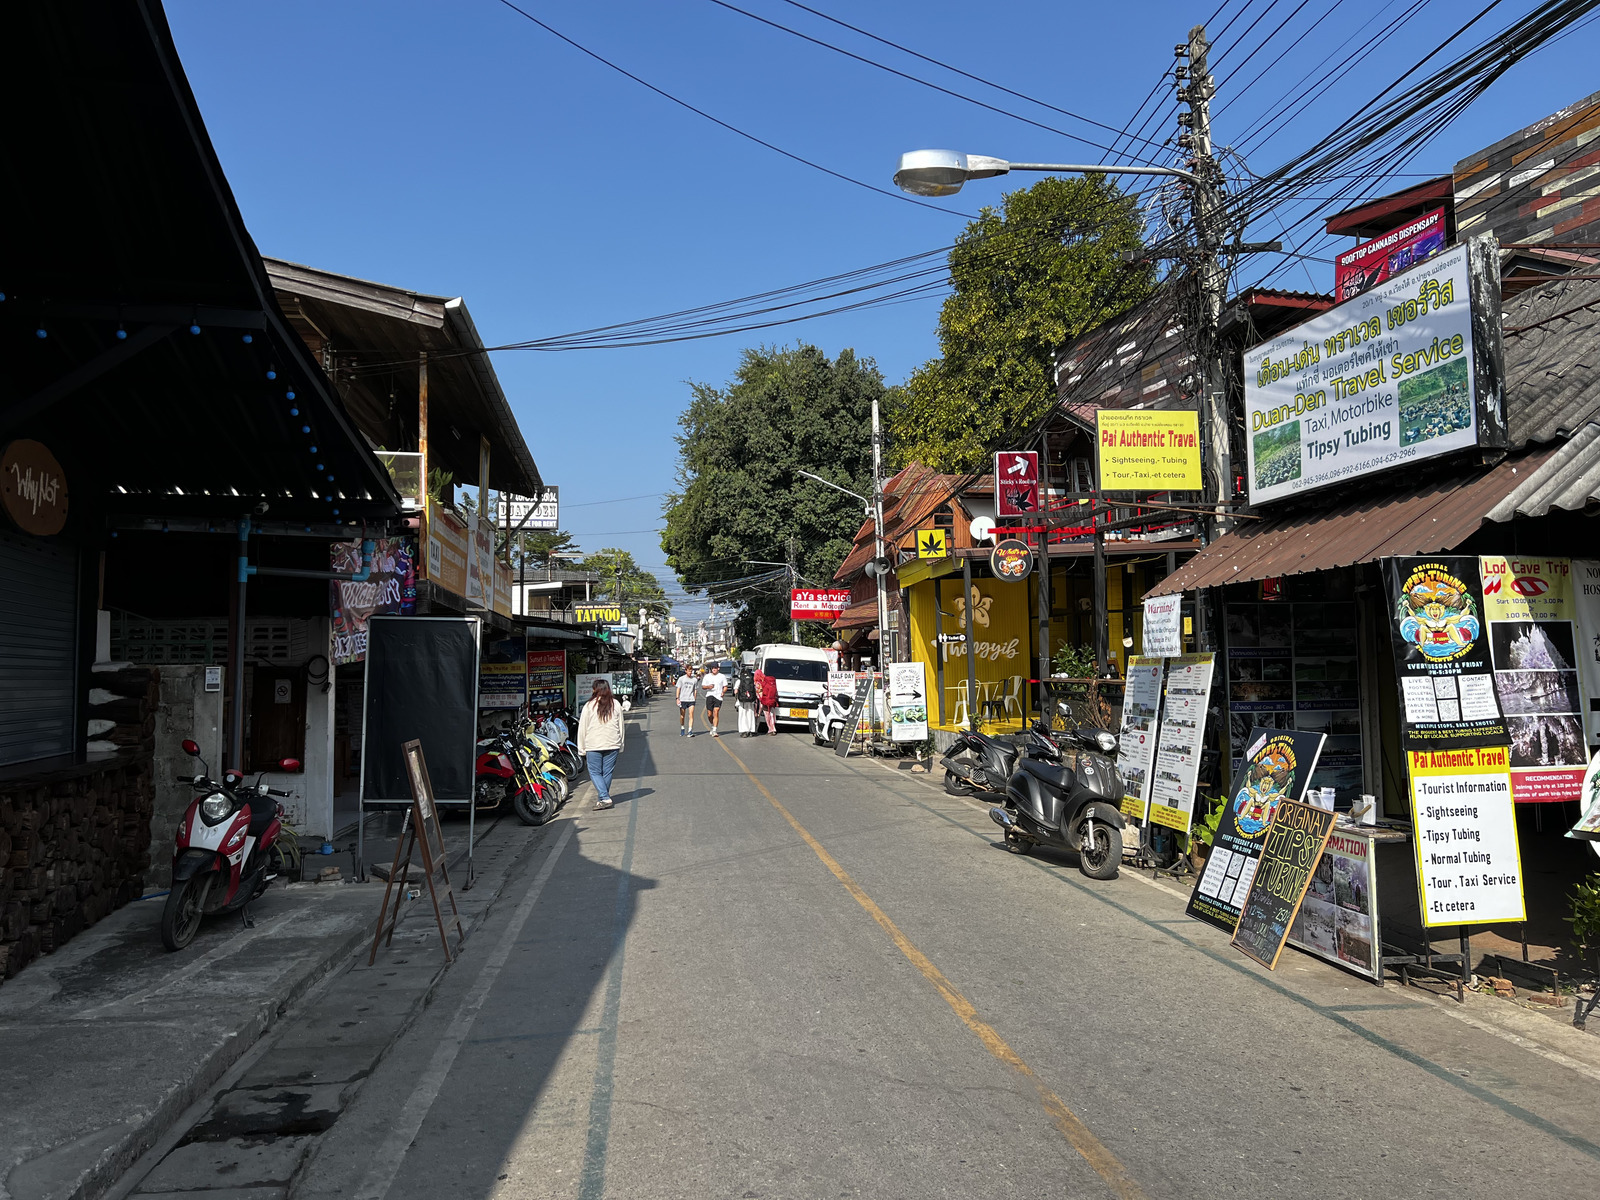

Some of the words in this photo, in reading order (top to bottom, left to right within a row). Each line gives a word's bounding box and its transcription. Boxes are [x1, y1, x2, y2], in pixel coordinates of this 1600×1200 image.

[1341, 247, 1367, 266] ROOFTOP
[1367, 234, 1398, 255] CANNABIS
[1398, 213, 1439, 241] DISPENSARY
[1324, 316, 1381, 358] ทราเวล
[1252, 389, 1326, 433] Duan-Den
[1330, 360, 1386, 402] Travel
[1391, 333, 1464, 379] Service
[1102, 430, 1117, 448] Pai
[1120, 430, 1166, 448] Authentic
[1168, 430, 1197, 448] Travel
[1307, 438, 1340, 460] Tipsy
[1344, 420, 1391, 448] Tubing
[1162, 456, 1188, 465] Tubing
[1412, 563, 1448, 572] ORIGINAL
[1484, 561, 1506, 574] Lod
[1512, 561, 1540, 574] Cave
[1546, 561, 1569, 576] Trip
[1428, 570, 1468, 594] TUBING
[796, 592, 814, 601] aYa
[575, 608, 620, 622] TATTOO
[1148, 600, 1176, 615] Warning!
[1414, 750, 1428, 769] Pai
[1430, 749, 1474, 768] Authentic
[1476, 748, 1506, 766] Travel
[1456, 780, 1507, 794] Information
[1276, 802, 1326, 838] ORIGINAL
[1426, 805, 1478, 820] Sightseeing
[1452, 828, 1480, 842] Tubing
[1268, 823, 1323, 870] TIPSY
[1326, 836, 1368, 858] RMATION
[1430, 852, 1462, 865] Normal
[1463, 852, 1492, 865] Tubing
[1459, 875, 1478, 887] Taxi
[1482, 874, 1516, 886] Service
[1446, 901, 1475, 912] cetera
